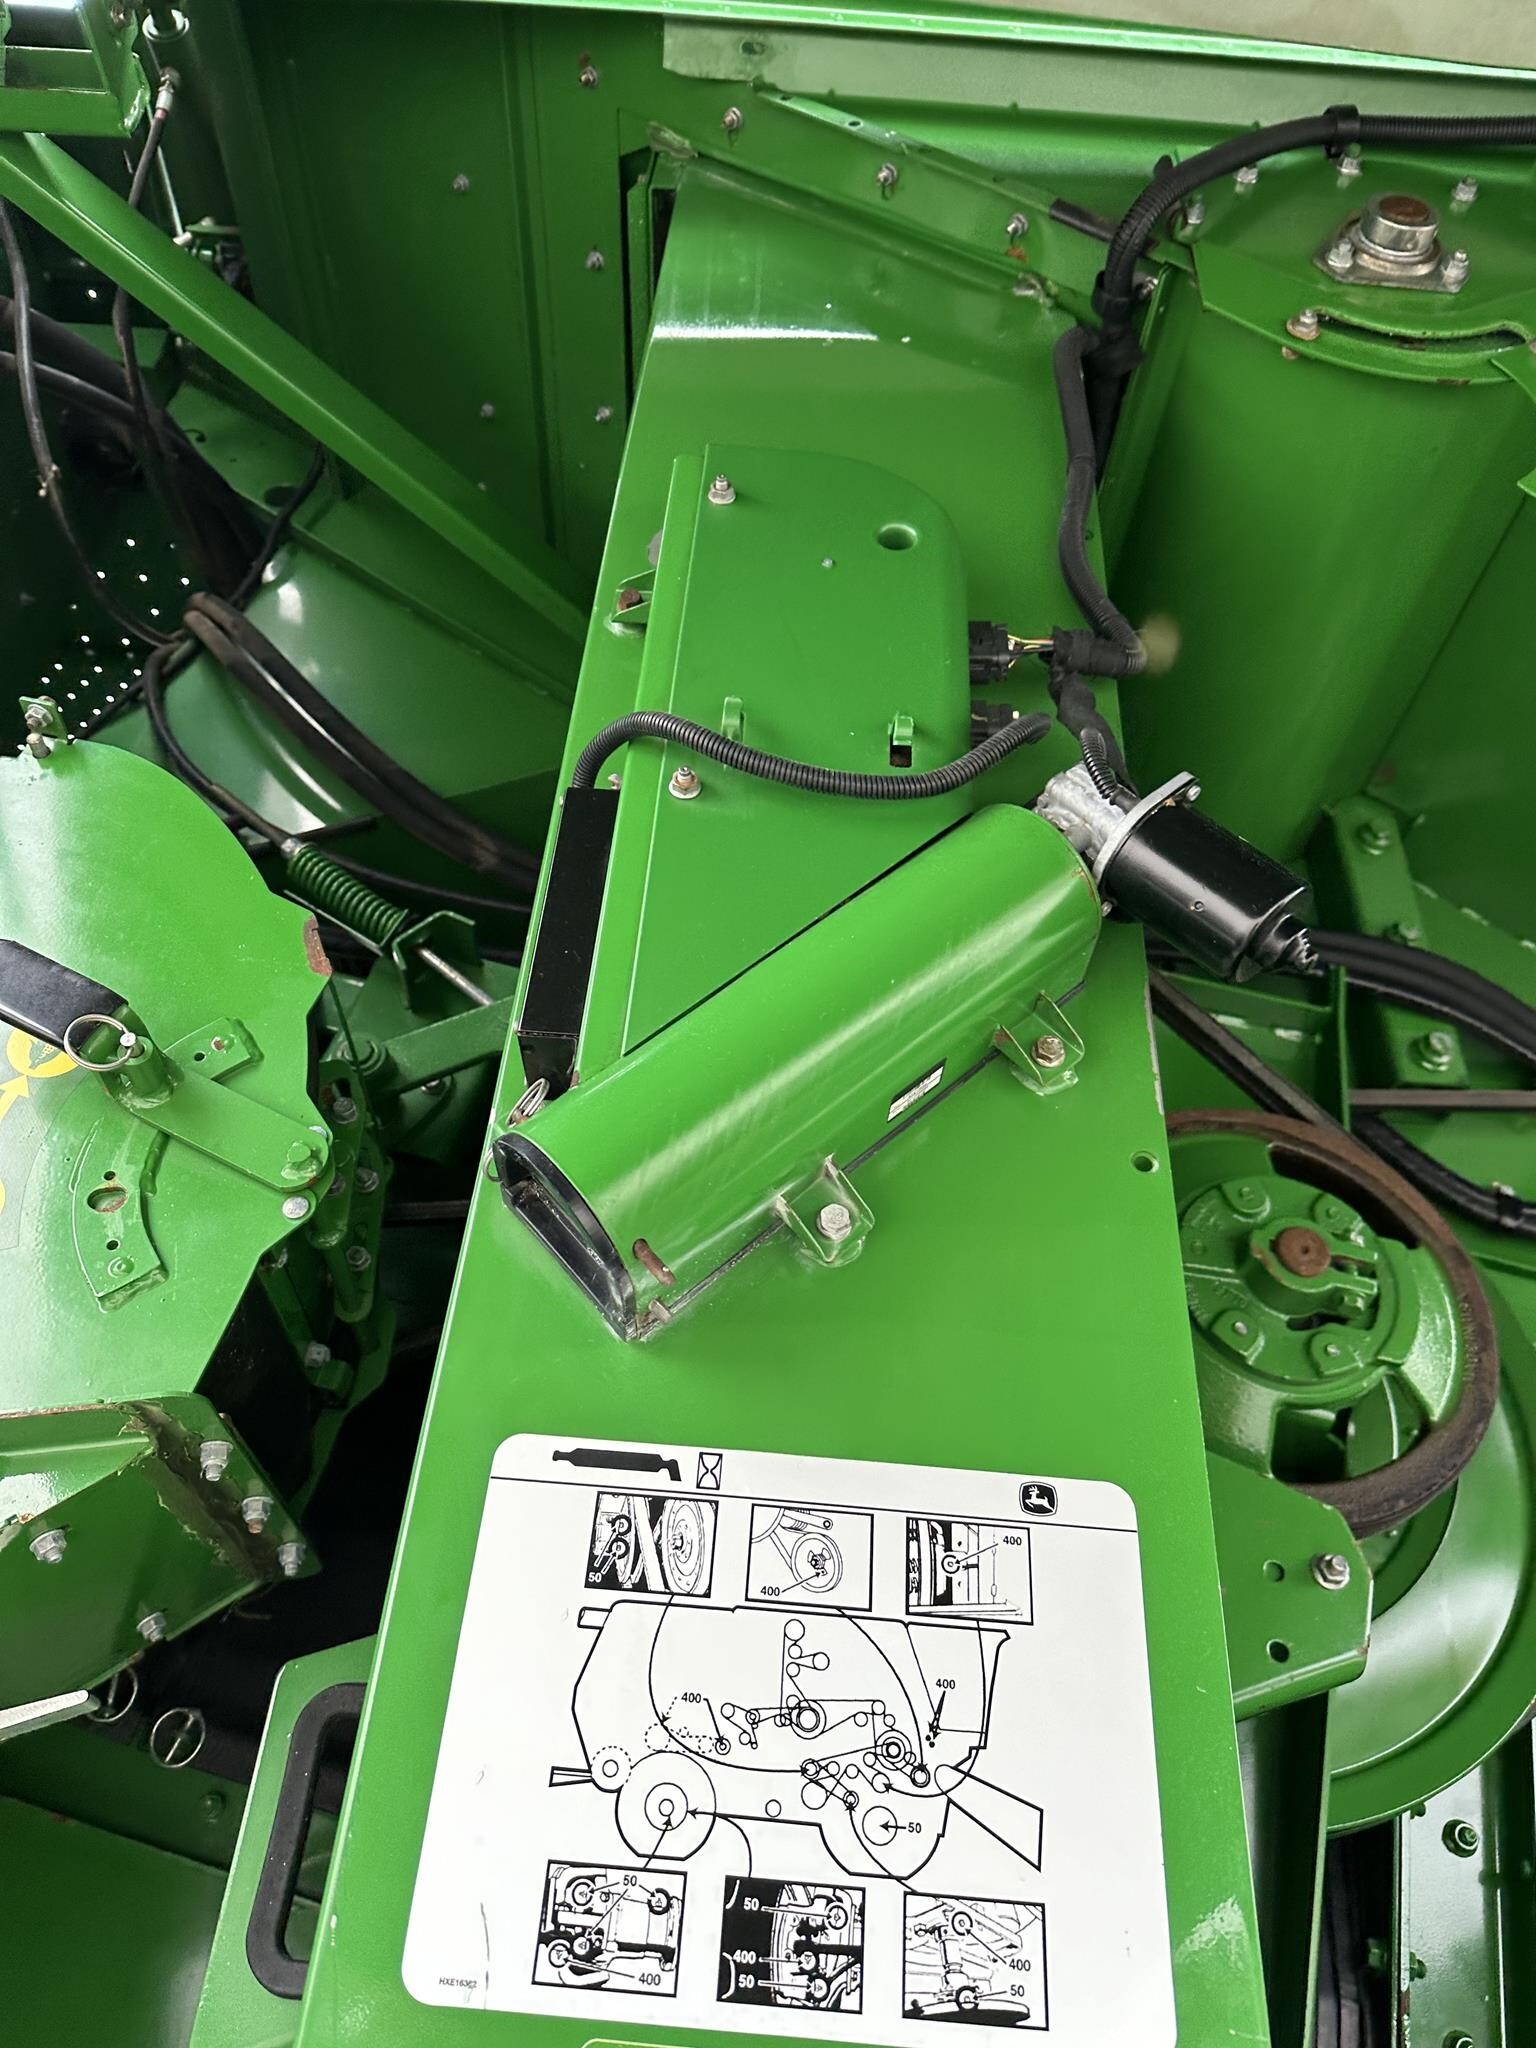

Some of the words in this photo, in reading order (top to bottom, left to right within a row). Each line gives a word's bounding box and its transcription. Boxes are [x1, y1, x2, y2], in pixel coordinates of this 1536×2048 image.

[1002, 1535, 1022, 1546] 400
[588, 1571, 602, 1583] 50
[760, 1585, 781, 1597] 400
[935, 1677, 956, 1690] 400
[680, 1692, 702, 1704] 400
[907, 1821, 922, 1834] 50
[622, 1874, 638, 1887] 50
[743, 1896, 760, 1911] 50
[732, 1949, 757, 1964] 400
[1008, 1958, 1031, 1972] 400
[638, 1972, 661, 1986] 400
[738, 1973, 755, 1989] 50
[1010, 1984, 1025, 1998] 50
